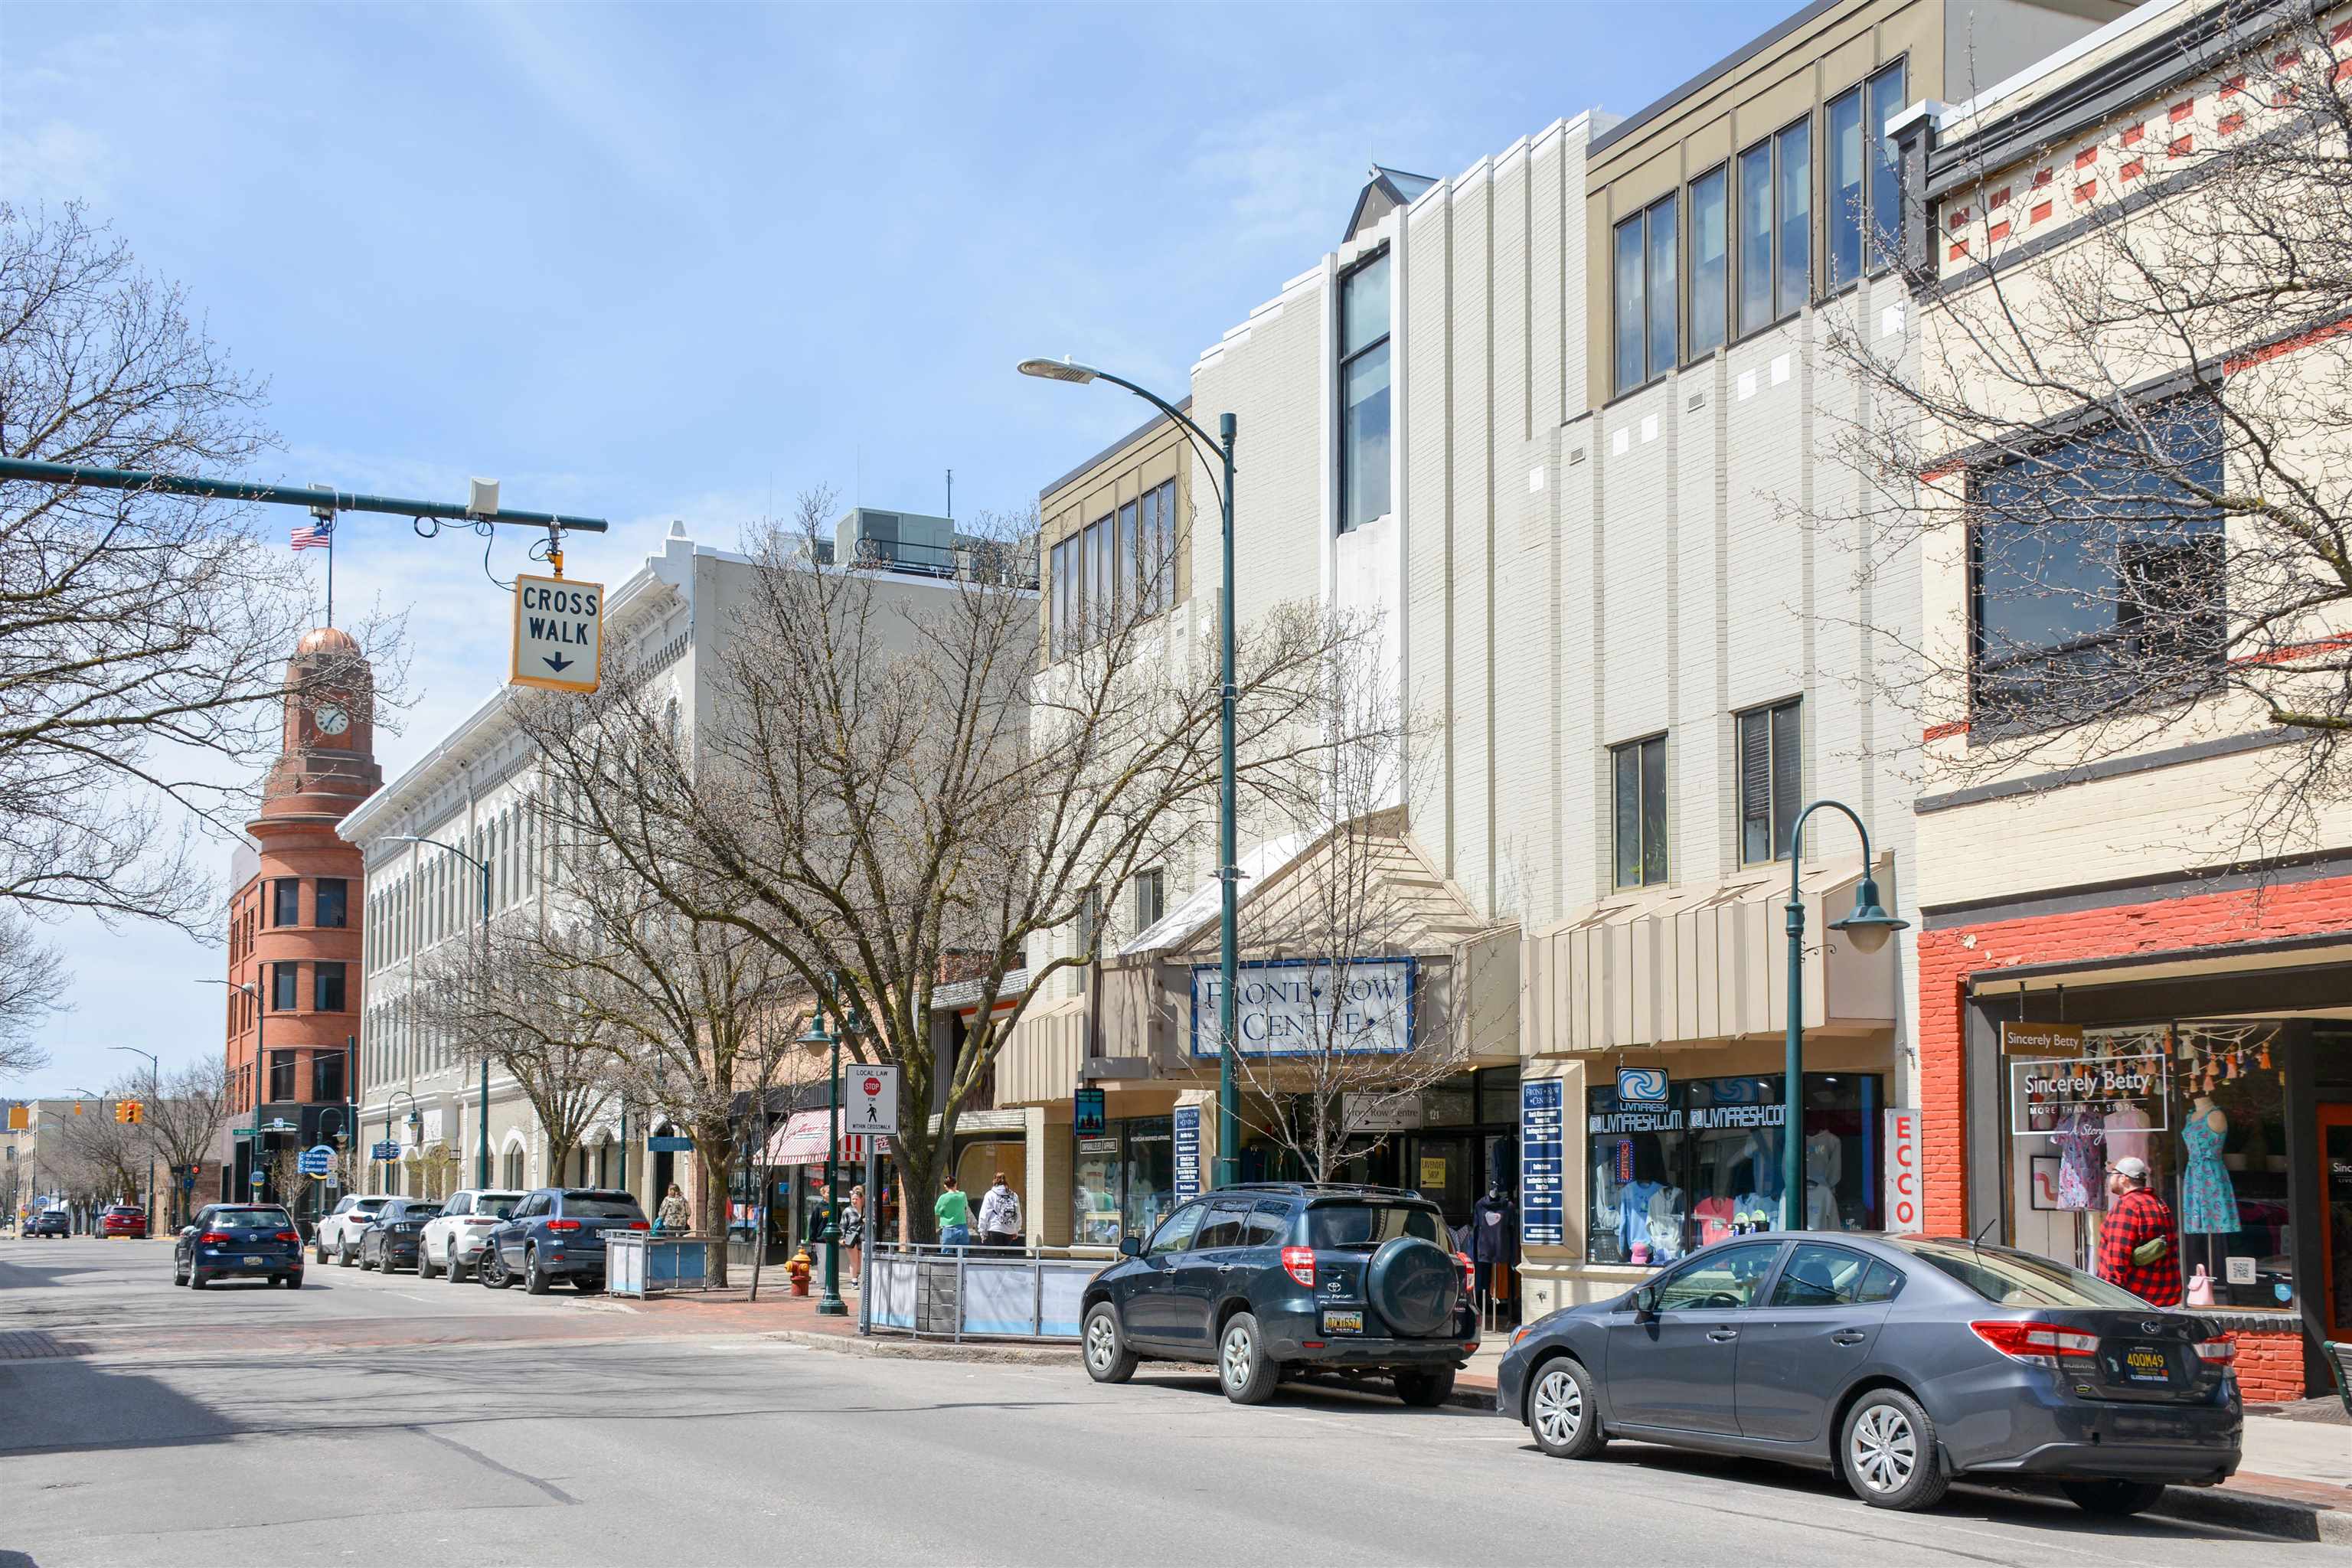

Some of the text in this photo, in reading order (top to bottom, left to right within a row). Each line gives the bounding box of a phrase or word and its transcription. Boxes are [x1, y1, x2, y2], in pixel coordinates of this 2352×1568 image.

[524, 586, 597, 616] CROSS
[529, 617, 588, 645] WALK
[1205, 982, 1308, 1009] FONT
[2007, 1032, 2079, 1049] Sincerely Betty
[1525, 1088, 1543, 1096] FRONT
[2024, 1070, 2150, 1097] Sincerely Betty
[1371, 1109, 1390, 1117] Row
[1429, 1110, 1439, 1120] 121
[2029, 1106, 2056, 1116] MORE
[2062, 1105, 2087, 1114] THAN
[2069, 1123, 2106, 1145] A Story
[1422, 1158, 1445, 1169] LAVENDER
[1620, 1142, 1630, 1180] OPEN
[1896, 1116, 1914, 1224] ECCO
